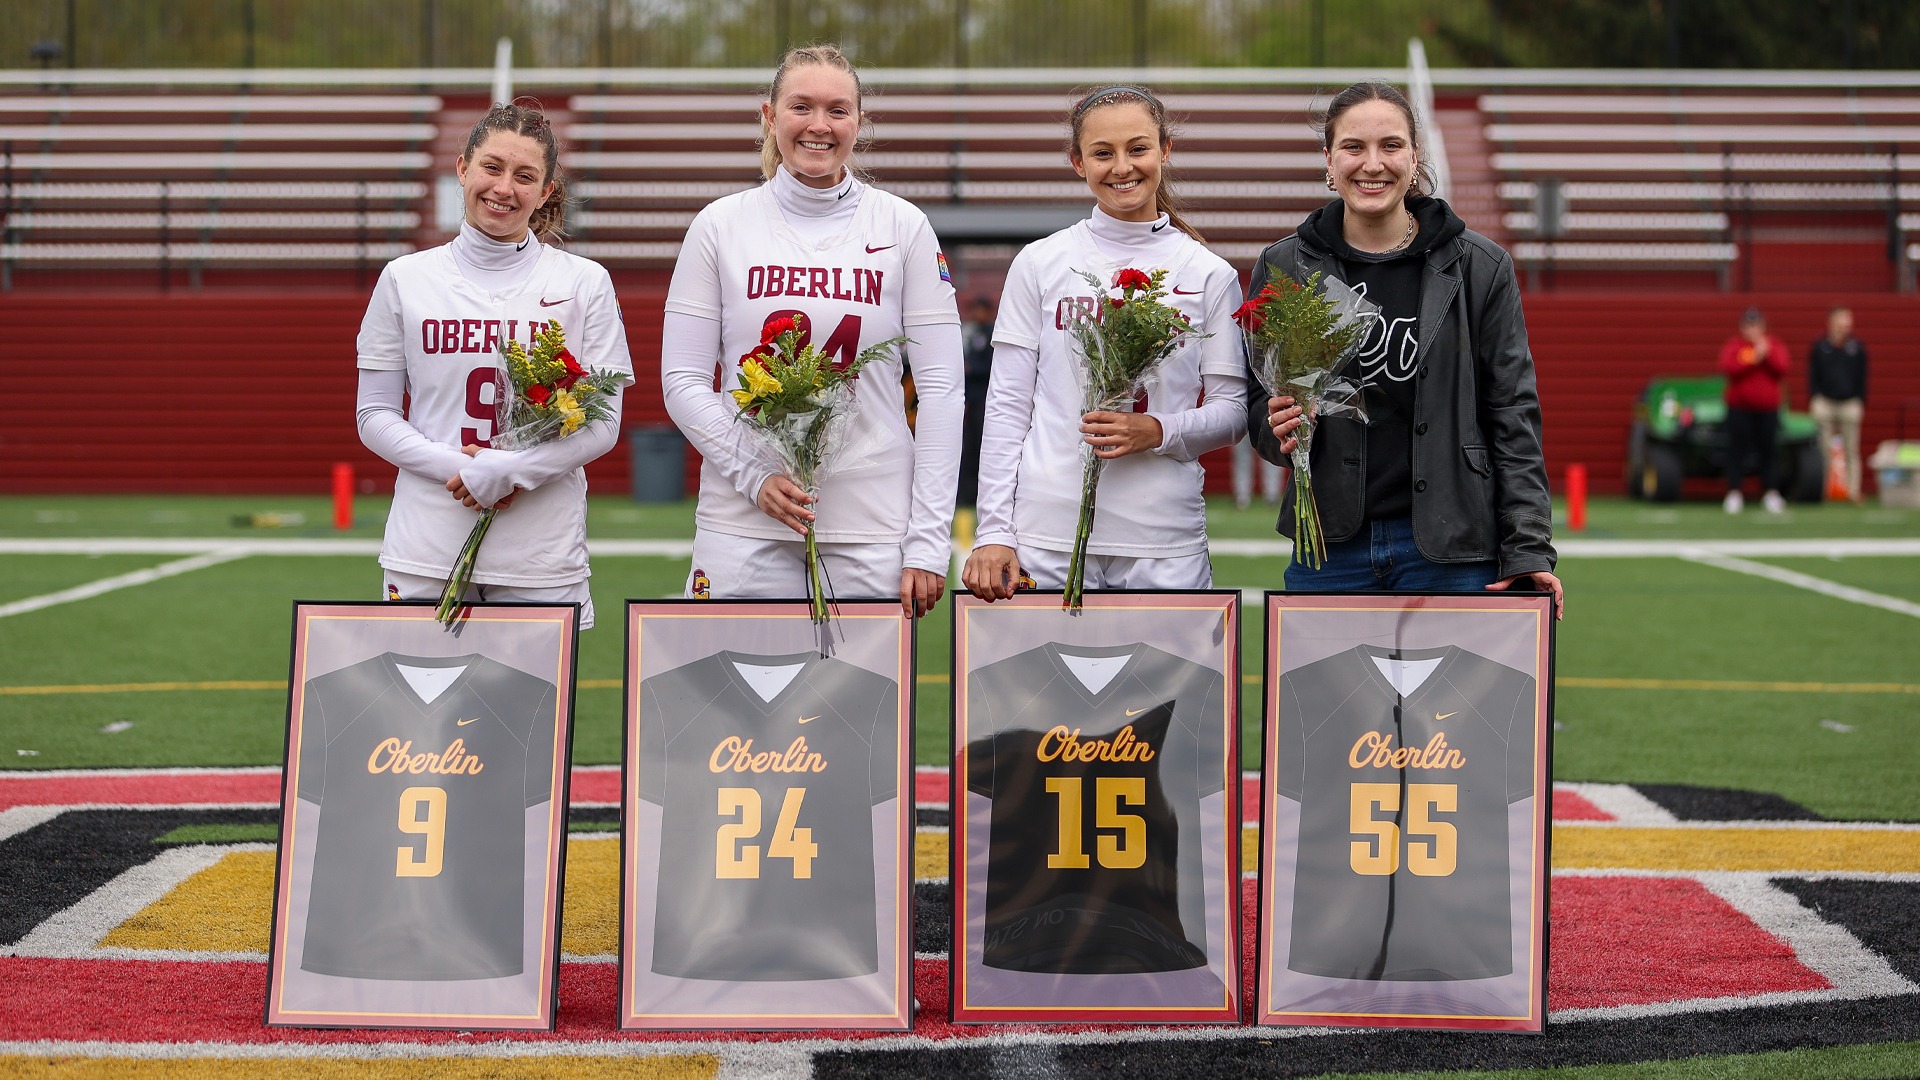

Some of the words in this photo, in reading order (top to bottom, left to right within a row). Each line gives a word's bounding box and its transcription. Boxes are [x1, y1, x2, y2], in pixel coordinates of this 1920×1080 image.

[747, 265, 884, 307] OBERLIN
[367, 736, 484, 776] Oberlin
[708, 735, 828, 774] Oberlin
[1036, 724, 1155, 763] Oberlin
[1348, 730, 1467, 770] Oberlin
[395, 786, 448, 878] 9
[715, 787, 818, 879] 24
[1045, 777, 1147, 869] 15
[1349, 782, 1459, 877] 55
